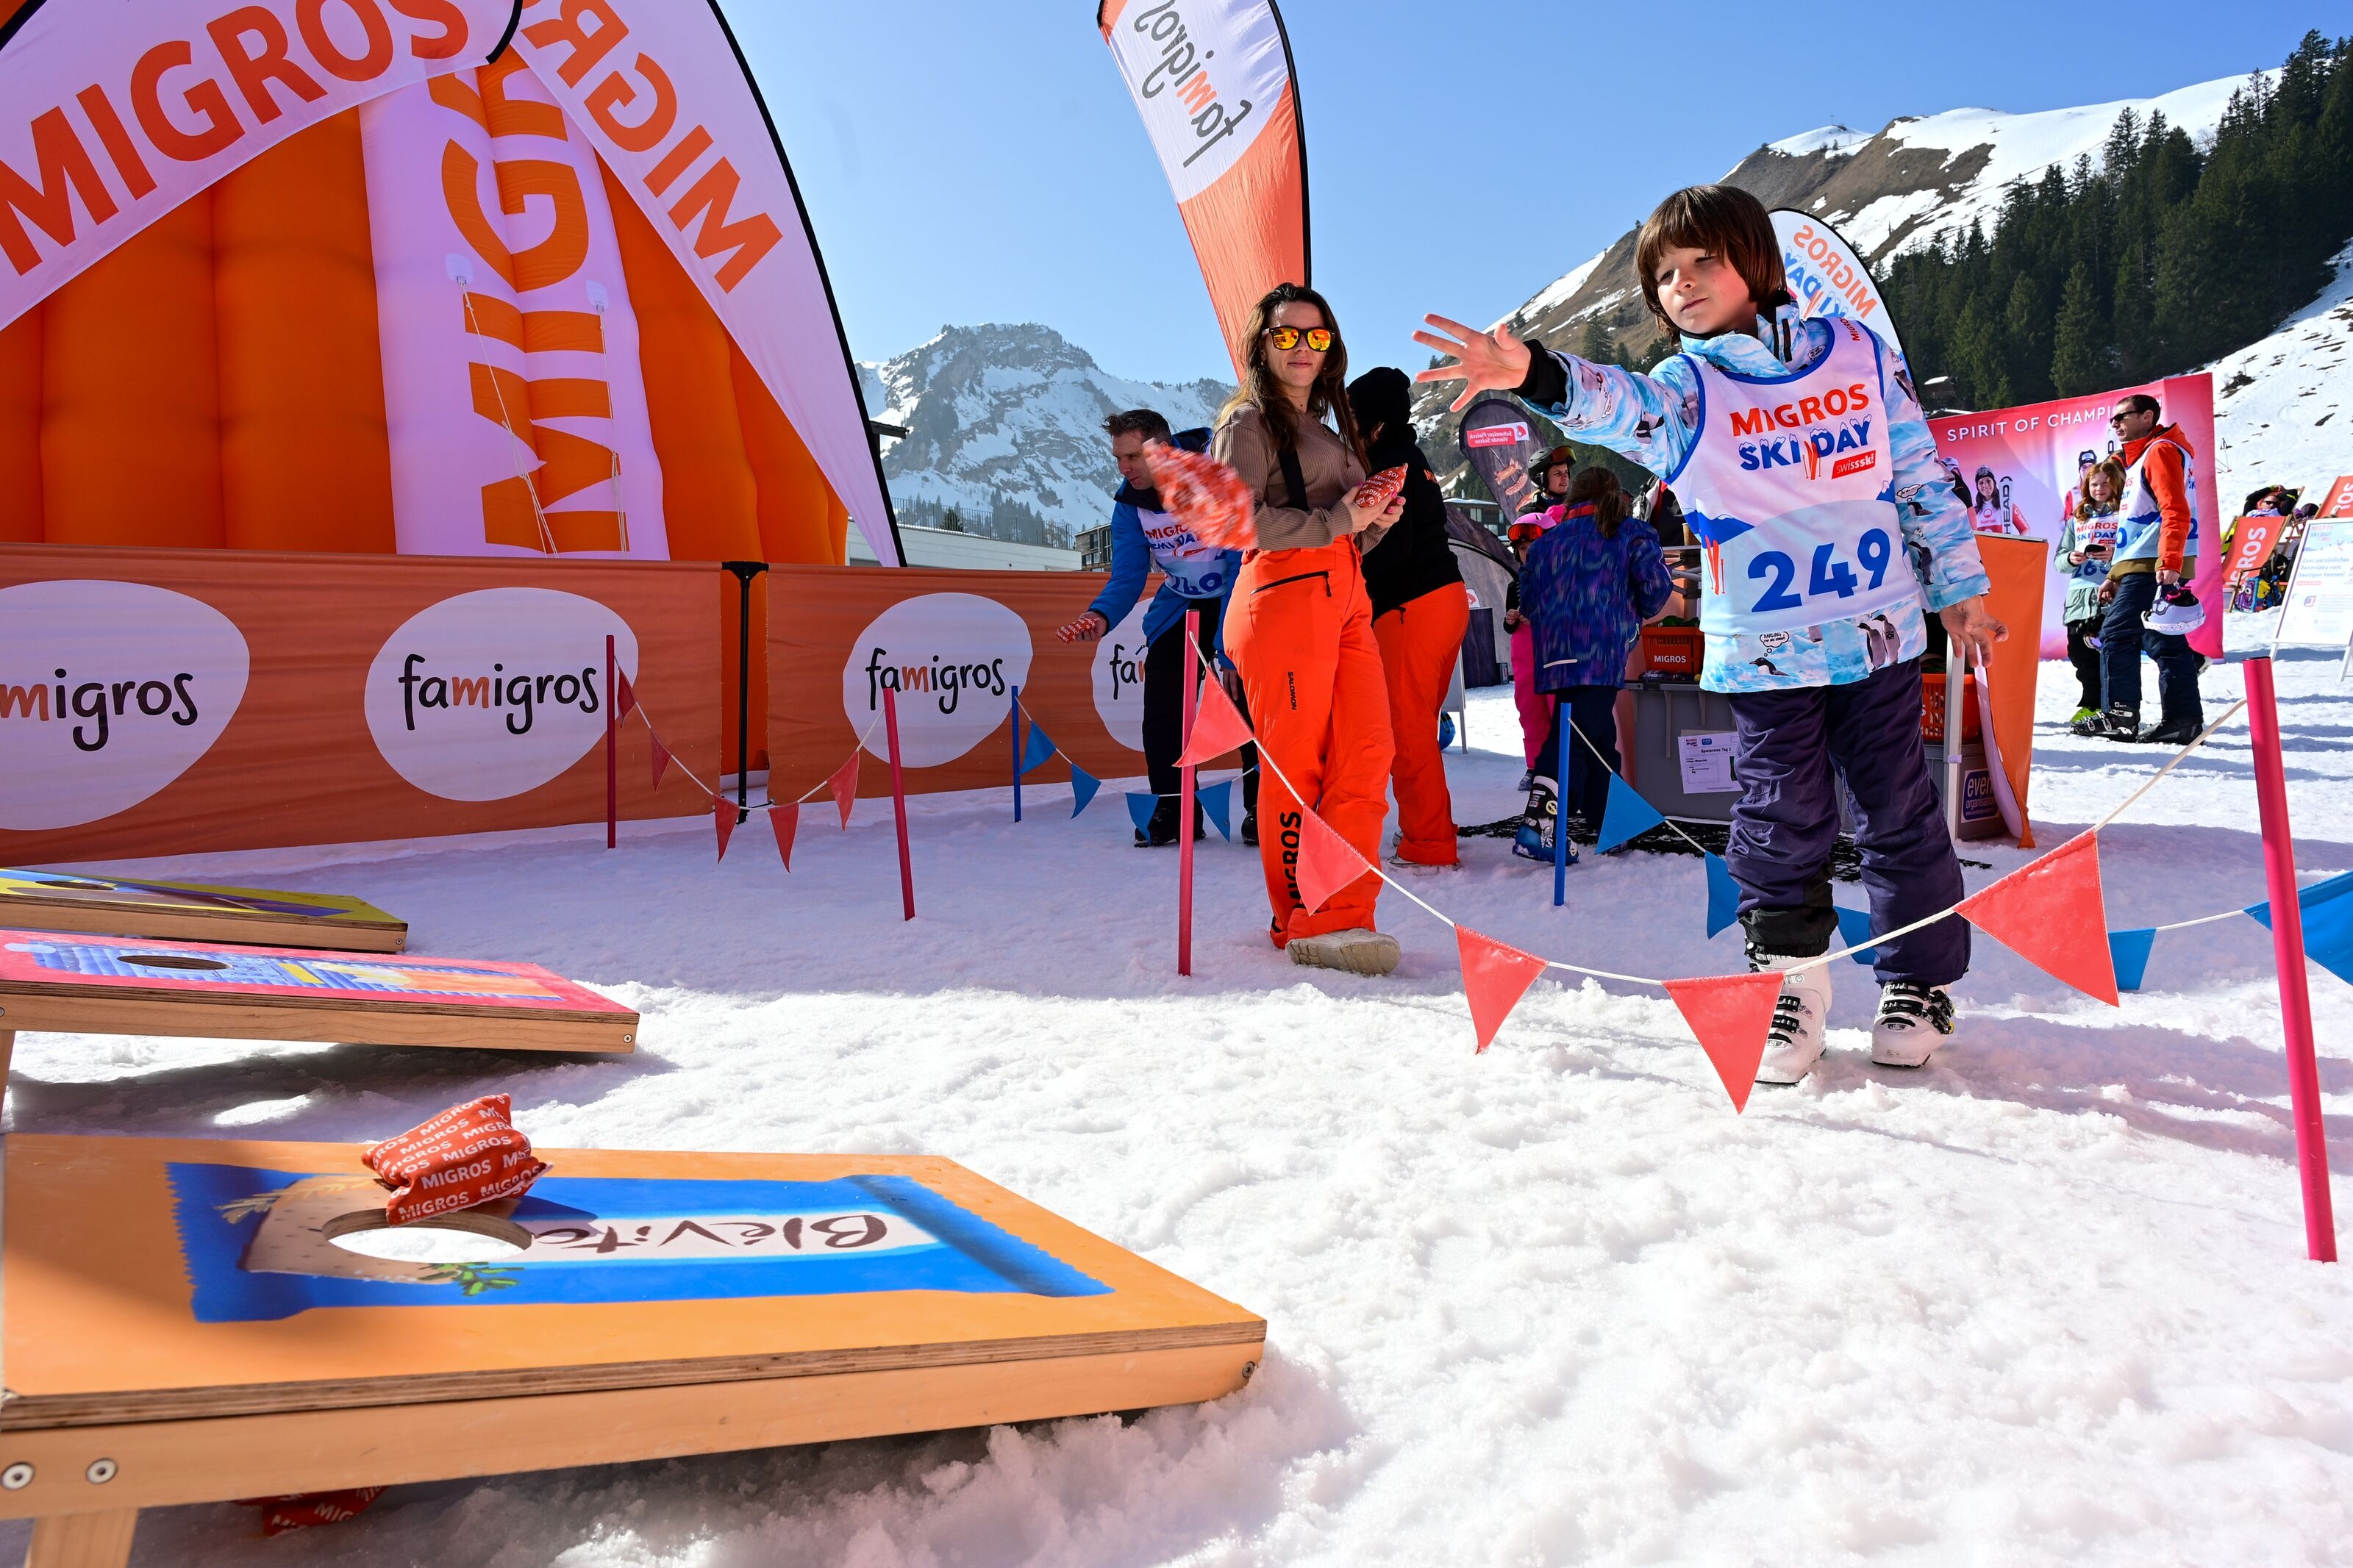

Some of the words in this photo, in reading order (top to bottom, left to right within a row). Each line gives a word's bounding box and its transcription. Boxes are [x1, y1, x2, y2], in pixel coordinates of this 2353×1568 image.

[1729, 383, 1869, 437] MIGROS
[1946, 421, 2007, 442] SPIRIT
[2014, 417, 2040, 432] OF
[2047, 405, 2117, 429] CHAMPI
[1738, 433, 1802, 471] SKI
[1810, 413, 1872, 459] DAY
[1835, 453, 1875, 474] swissski
[2076, 522, 2118, 533] MIGROS
[2077, 533, 2090, 541] SKI
[1747, 528, 1891, 613] 249
[1654, 655, 1687, 663] MIGROS
[398, 654, 599, 734] famigros
[865, 648, 1005, 714] famigros
[1288, 671, 1297, 711] SALOMON
[399, 1118, 470, 1154] MIGROS
[442, 1136, 513, 1161] MIGROS
[388, 1141, 452, 1180] MIGROS
[421, 1159, 492, 1189] MIGROS
[398, 1192, 470, 1220] MIGROS
